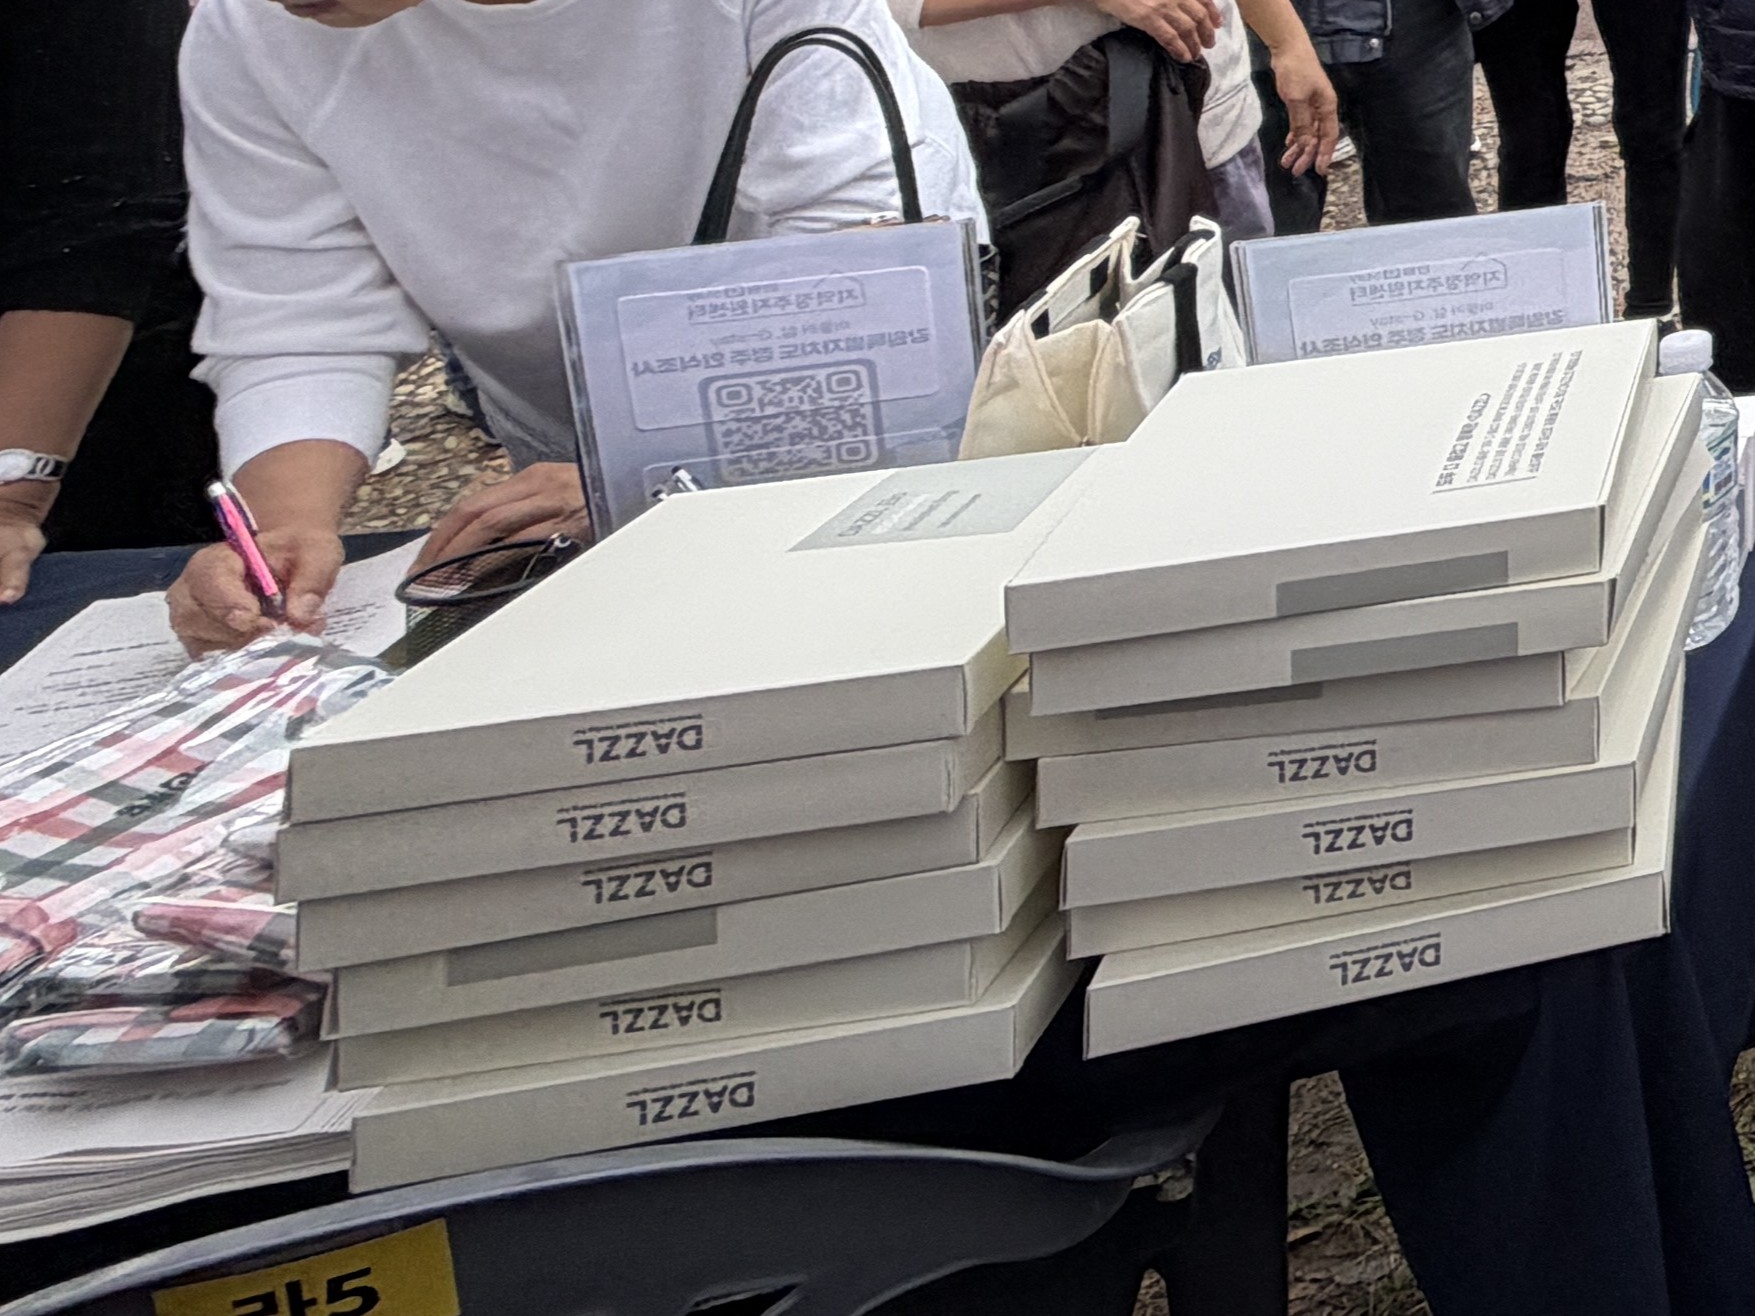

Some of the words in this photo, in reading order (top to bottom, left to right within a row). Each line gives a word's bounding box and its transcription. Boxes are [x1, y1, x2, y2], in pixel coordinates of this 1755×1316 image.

[572, 724, 703, 765] DAZZL
[1266, 749, 1377, 784] DAZZL
[557, 802, 687, 843] DAZZL
[1301, 818, 1414, 855] DAZZL
[581, 862, 713, 904] DAZZL
[1302, 869, 1412, 904] DAZZL
[1329, 942, 1442, 987] DAZZL
[600, 997, 722, 1035] DAZZL
[626, 1081, 755, 1126] DAZZL
